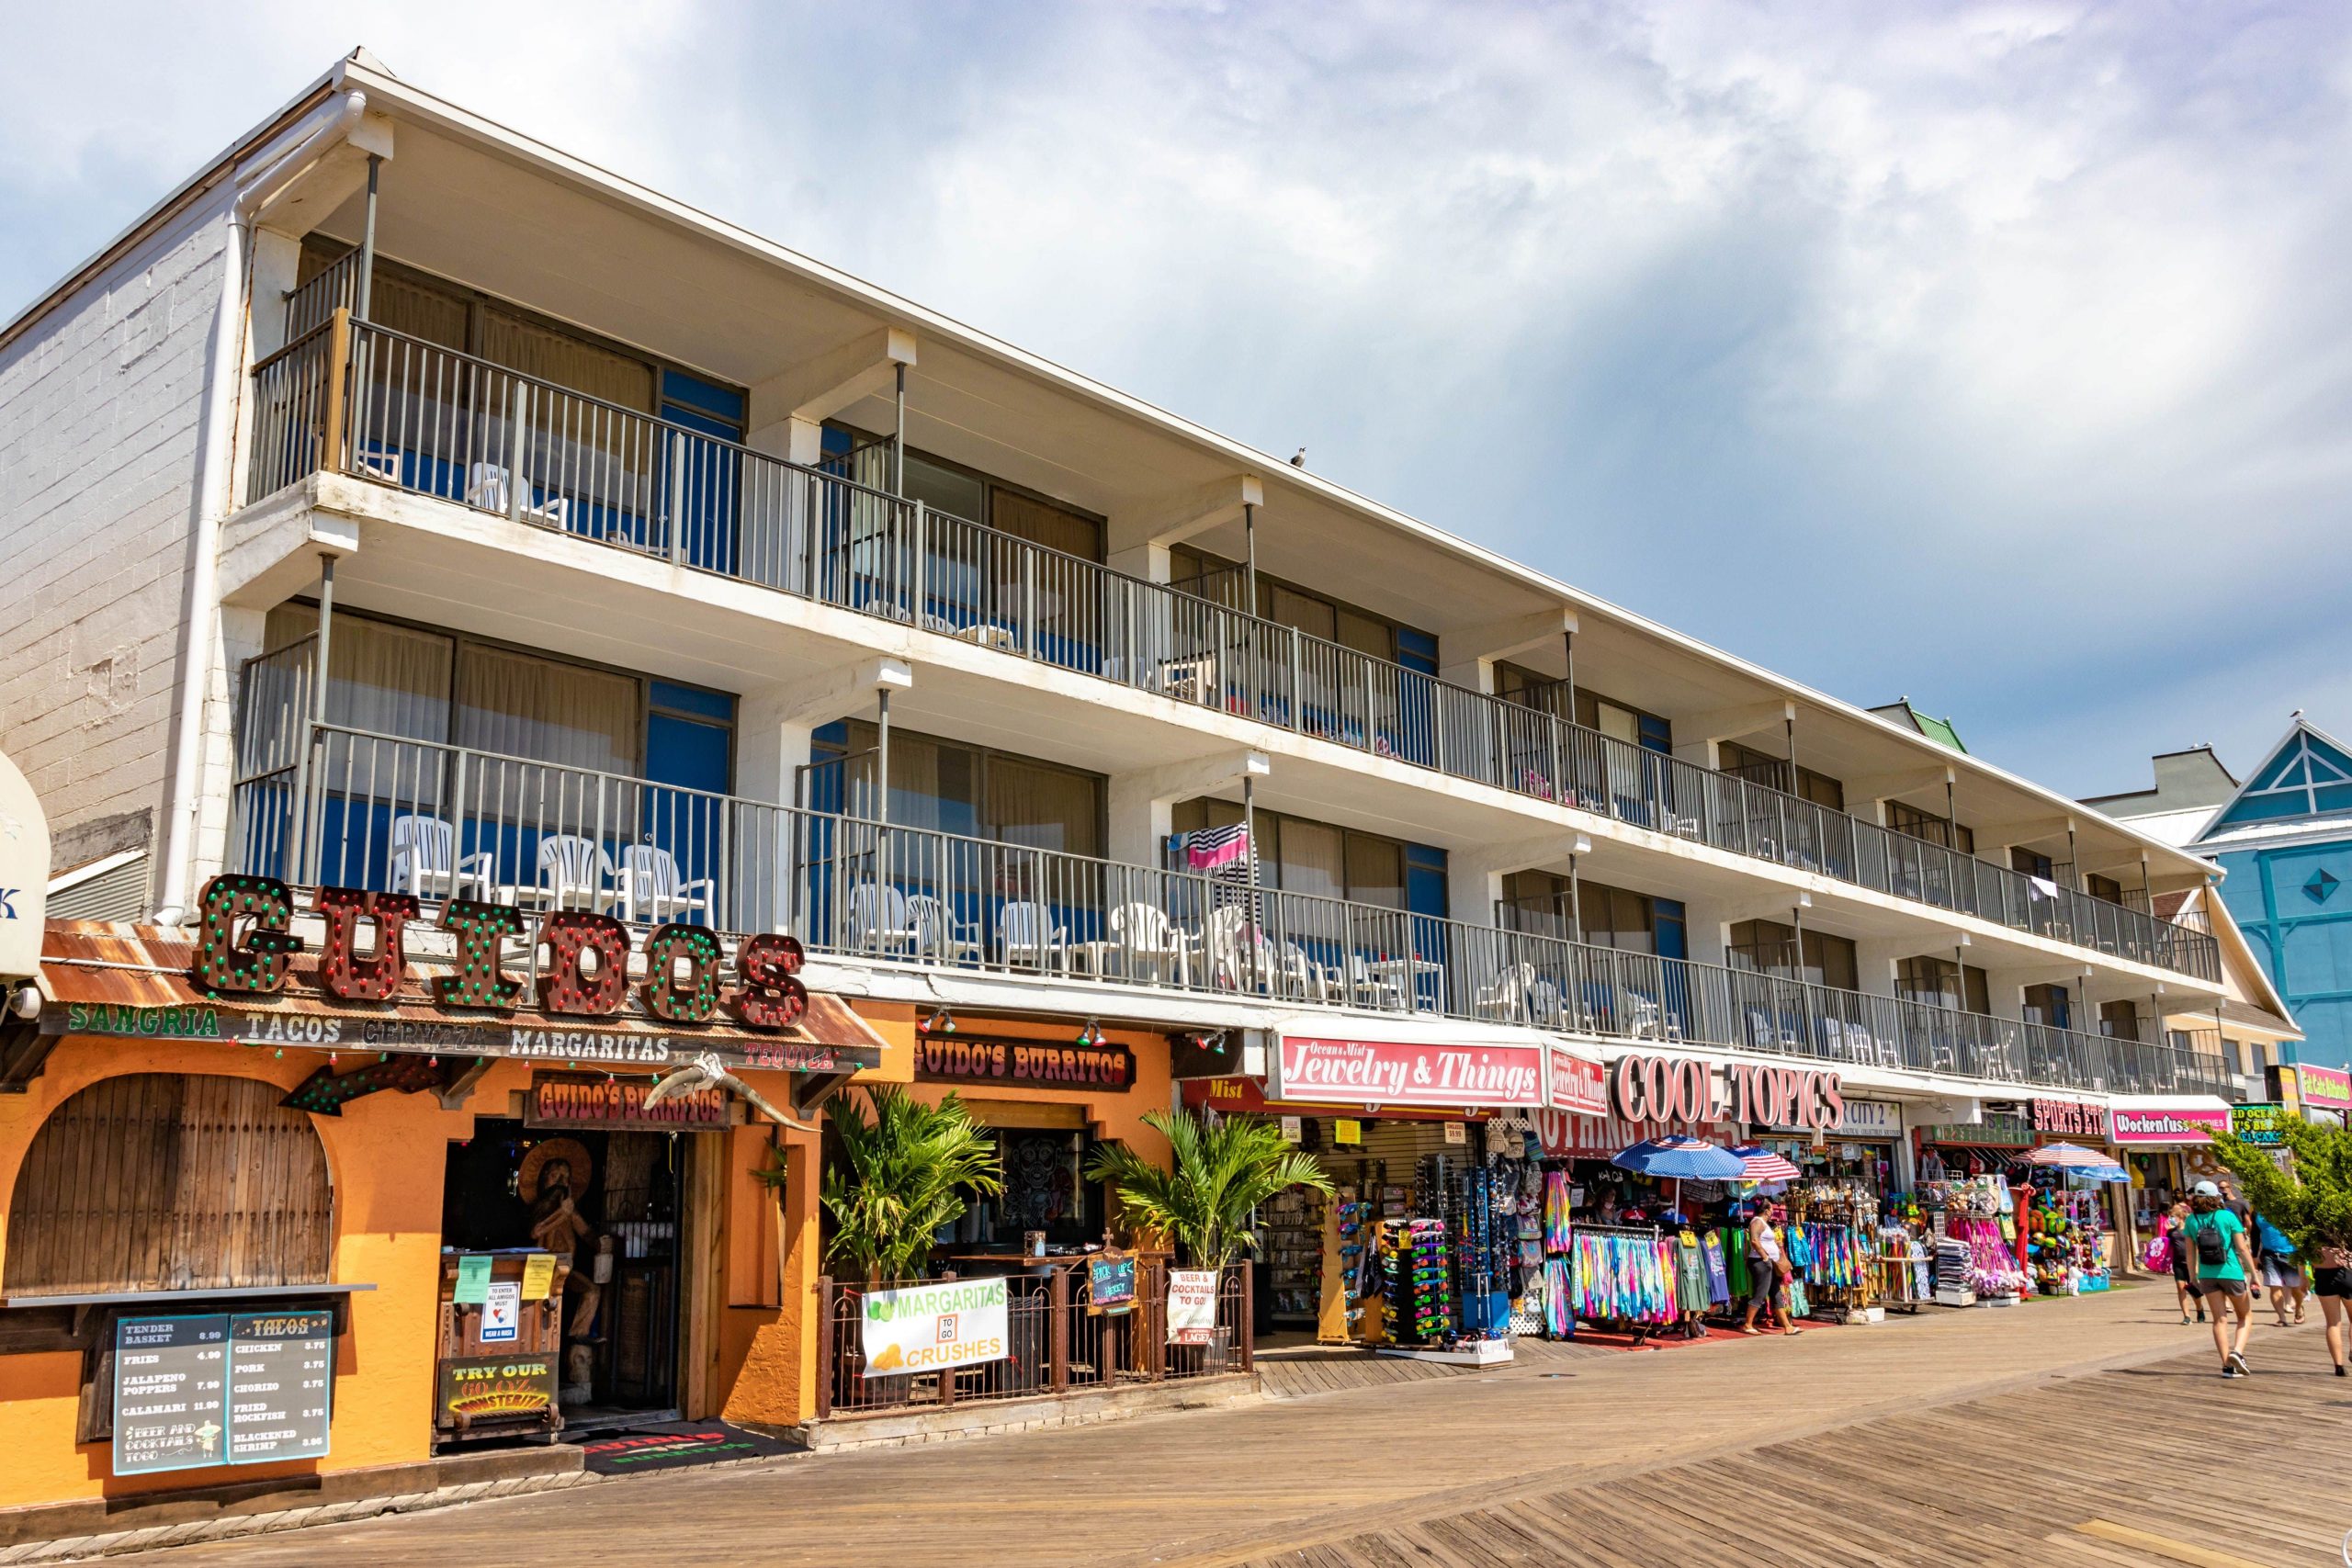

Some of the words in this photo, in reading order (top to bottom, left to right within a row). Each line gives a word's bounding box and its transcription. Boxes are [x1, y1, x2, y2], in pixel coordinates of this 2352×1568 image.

[192, 873, 809, 1028] GUIDOS
[68, 1002, 220, 1037] SANGRIA
[245, 1011, 342, 1043] TACOS
[361, 1019, 488, 1052] CERVEZA
[509, 1029, 670, 1062] MARGARITAS
[1344, 1043, 1367, 1057] Mist
[742, 1042, 835, 1071] TEQUILA
[1012, 1045, 1126, 1085] BURRITOS
[1283, 1044, 1409, 1096] Jewelry
[1413, 1055, 1432, 1085] &
[1436, 1051, 1537, 1099] Things
[1209, 1079, 1243, 1099] Mist
[1611, 1054, 1724, 1123] COOL
[1724, 1063, 1844, 1130] TOPICS
[538, 1082, 621, 1121] GUIDO'S
[624, 1085, 722, 1122] BURRITOS
[1850, 1103, 1876, 1124] CITY
[1878, 1104, 1884, 1125] 2
[2033, 1098, 2082, 1134] SPORTS
[2116, 1113, 2190, 1134] Wockenfuss
[1095, 1266, 1111, 1279] PICK
[1117, 1263, 1127, 1274] UP
[1180, 1273, 1201, 1282] BEER
[1203, 1273, 1208, 1282] &
[1171, 1284, 1215, 1294] COCKTAILS
[897, 1283, 1006, 1319] MARGARITAS
[1180, 1296, 1192, 1305] TO
[1194, 1296, 1206, 1305] GO!
[125, 1324, 174, 1335] TENDER
[253, 1317, 309, 1337] TACOS
[943, 1319, 953, 1328] TO
[125, 1334, 173, 1345] BASKET
[198, 1331, 221, 1341] 8.99
[942, 1329, 953, 1339] GO
[235, 1343, 283, 1354] CHICKEN
[304, 1341, 326, 1350] 3.75
[906, 1337, 1001, 1368] CRUSHES
[124, 1355, 160, 1365] FRIES
[197, 1350, 221, 1360] 4.99
[234, 1363, 266, 1373] PORK
[303, 1360, 325, 1370] 3.75
[452, 1366, 498, 1381] TRY
[502, 1363, 548, 1378] OUR
[122, 1372, 187, 1385] JALAPENO
[122, 1383, 177, 1395] POPPERS
[197, 1381, 220, 1391] 7.99
[233, 1382, 279, 1393] CHORIZO
[302, 1380, 324, 1389] 3.75
[461, 1382, 489, 1396] 60
[121, 1404, 187, 1416] CALAMARI
[193, 1400, 220, 1411] 11.99
[233, 1403, 267, 1413] FRIED
[233, 1411, 287, 1423] ROCKFISH
[302, 1408, 324, 1417] 3.75
[135, 1426, 165, 1438] BEER
[170, 1423, 196, 1435] AND
[233, 1429, 297, 1443] BLACKENED
[125, 1435, 194, 1450] COCKTAILS
[233, 1441, 277, 1453] SHRIMP
